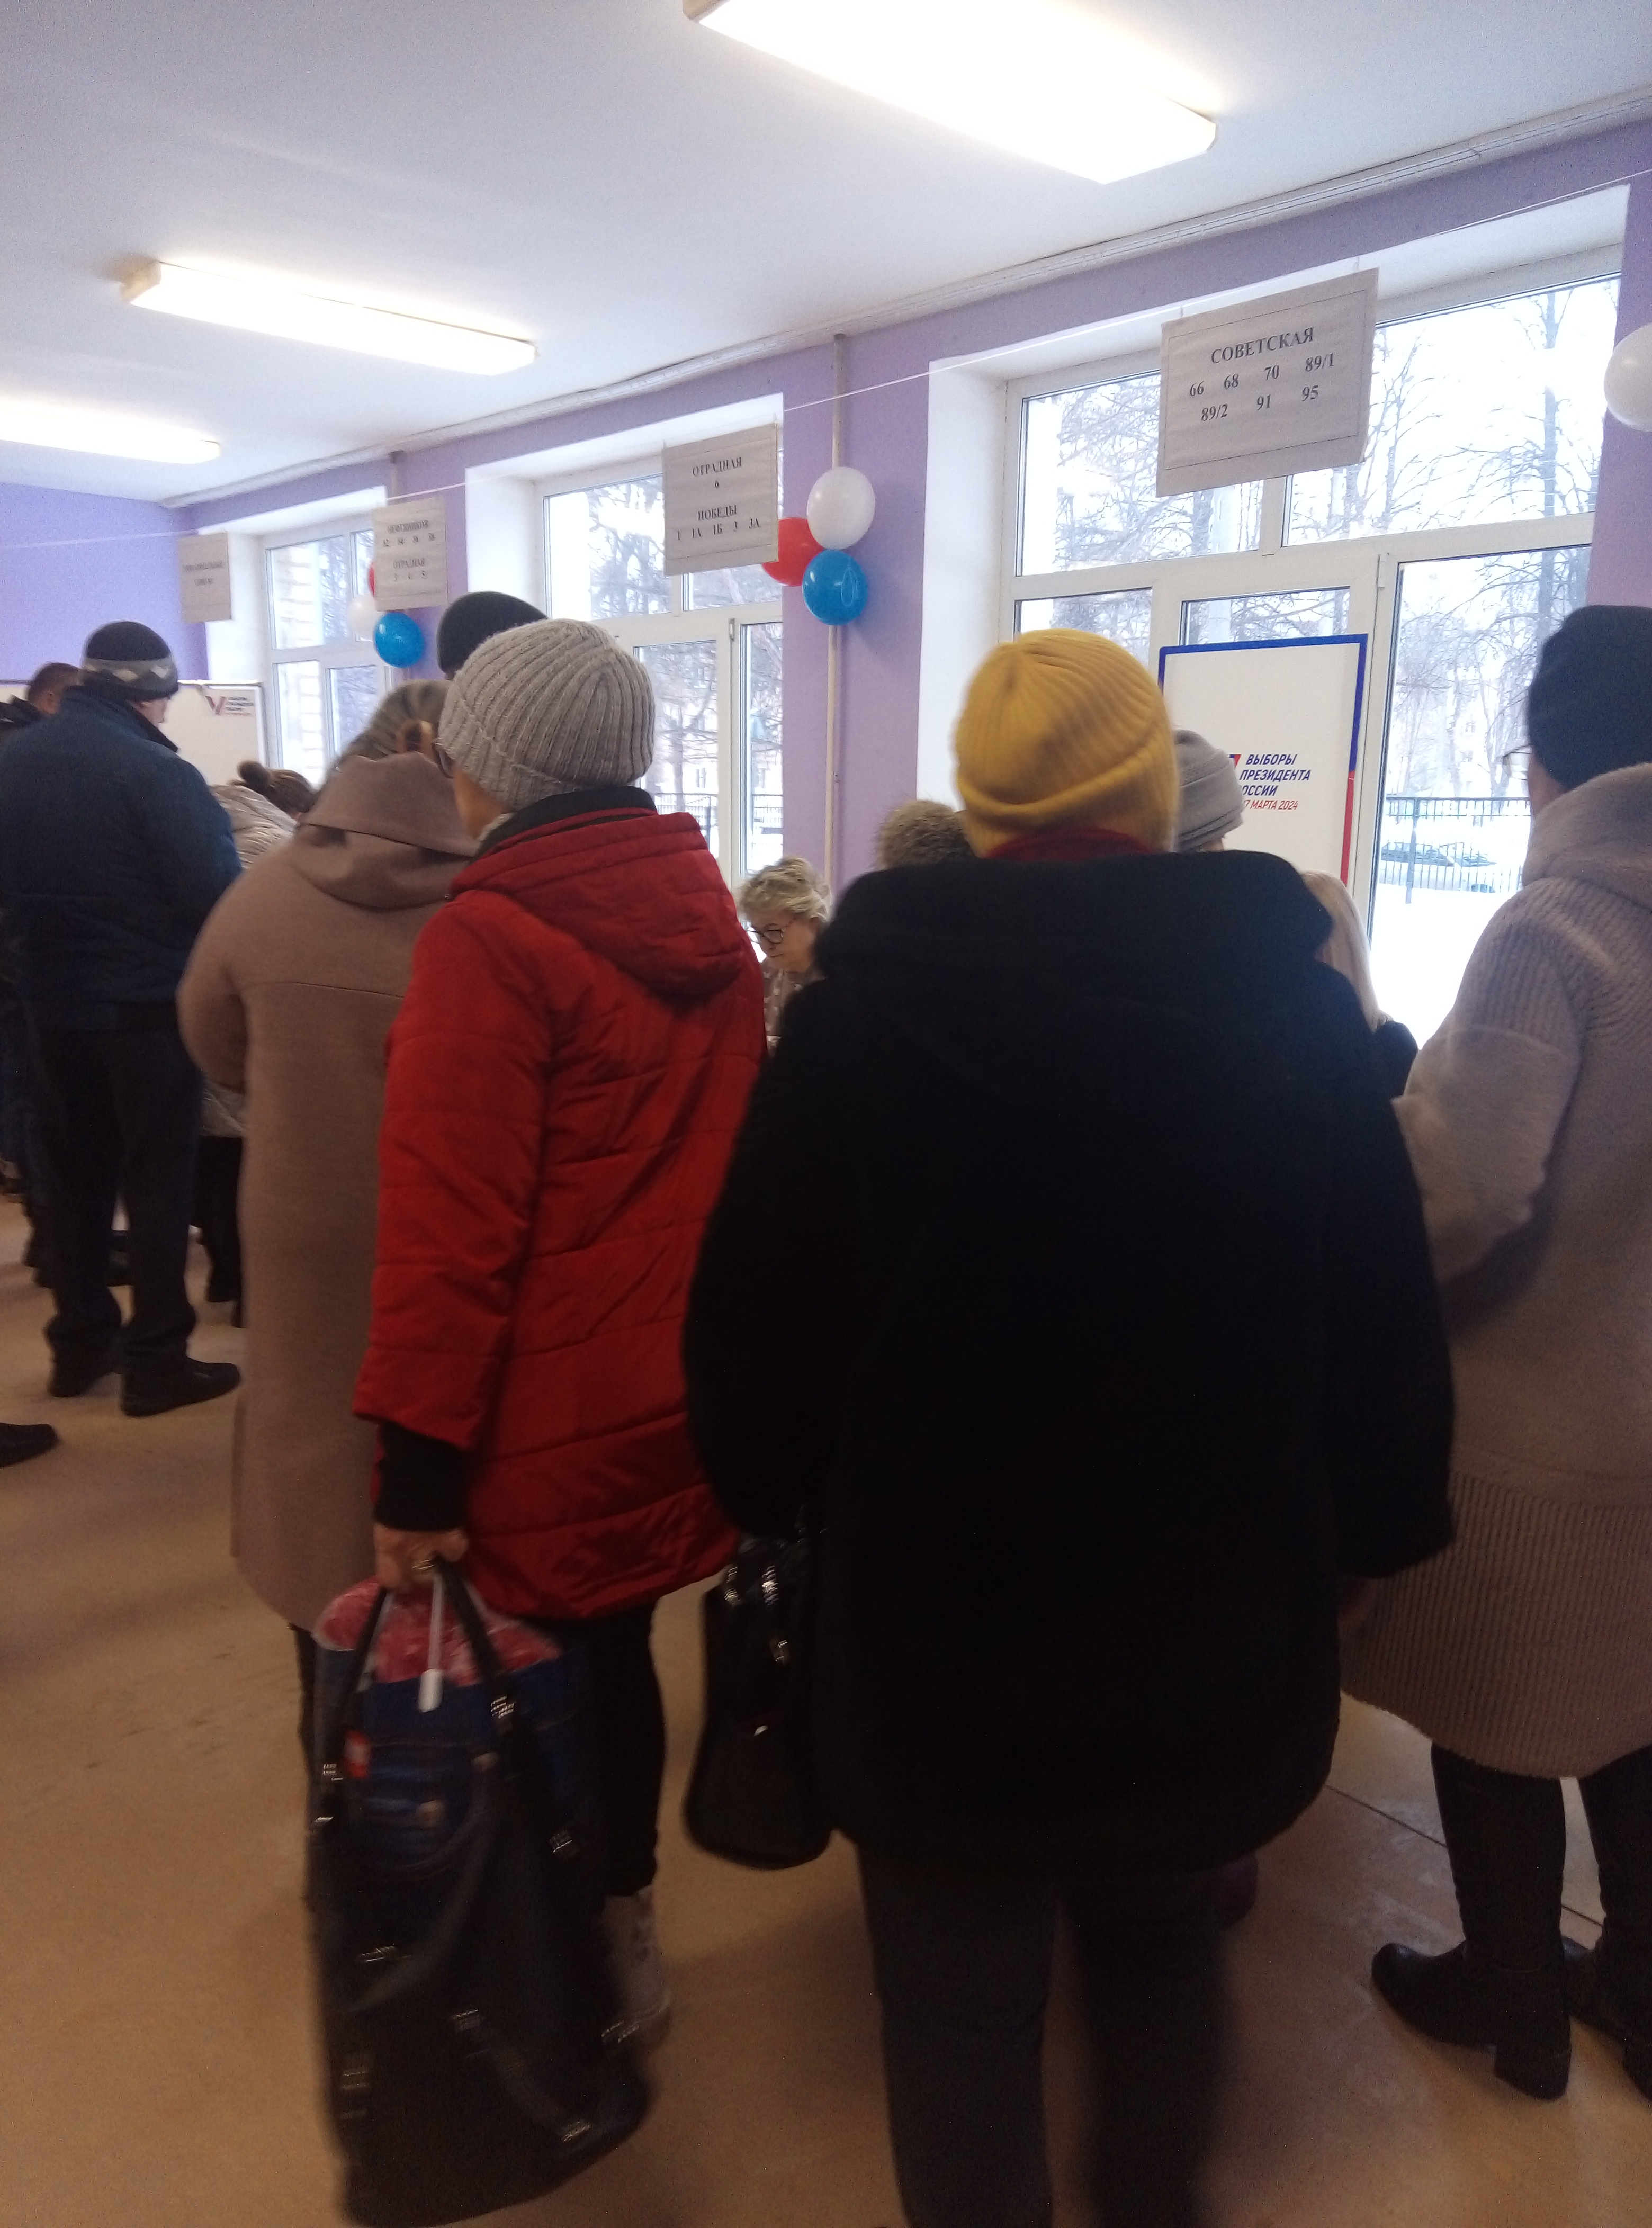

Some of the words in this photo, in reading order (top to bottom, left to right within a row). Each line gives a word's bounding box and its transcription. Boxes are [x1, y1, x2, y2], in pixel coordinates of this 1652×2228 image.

[1210, 327, 1315, 364] СОВЕТСКАЯ
[1189, 381, 1204, 397] 66
[1223, 373, 1240, 390] 68
[1264, 365, 1280, 381] 70
[1305, 353, 1335, 372] 89/1
[1201, 403, 1229, 422] 89/2
[1256, 394, 1271, 411] 91
[1301, 385, 1319, 402] 95
[692, 456, 742, 477] ОТРАДНАЯ
[698, 505, 737, 522] ПОБЕДЫ
[1245, 753, 1298, 766] ВЫБОРЫ
[1239, 769, 1312, 783] ПРЕЗИДЕНТА
[1240, 785, 1279, 796] ОССИИ
[1250, 799, 1277, 810] МАРТА
[1278, 799, 1299, 810] 2024
